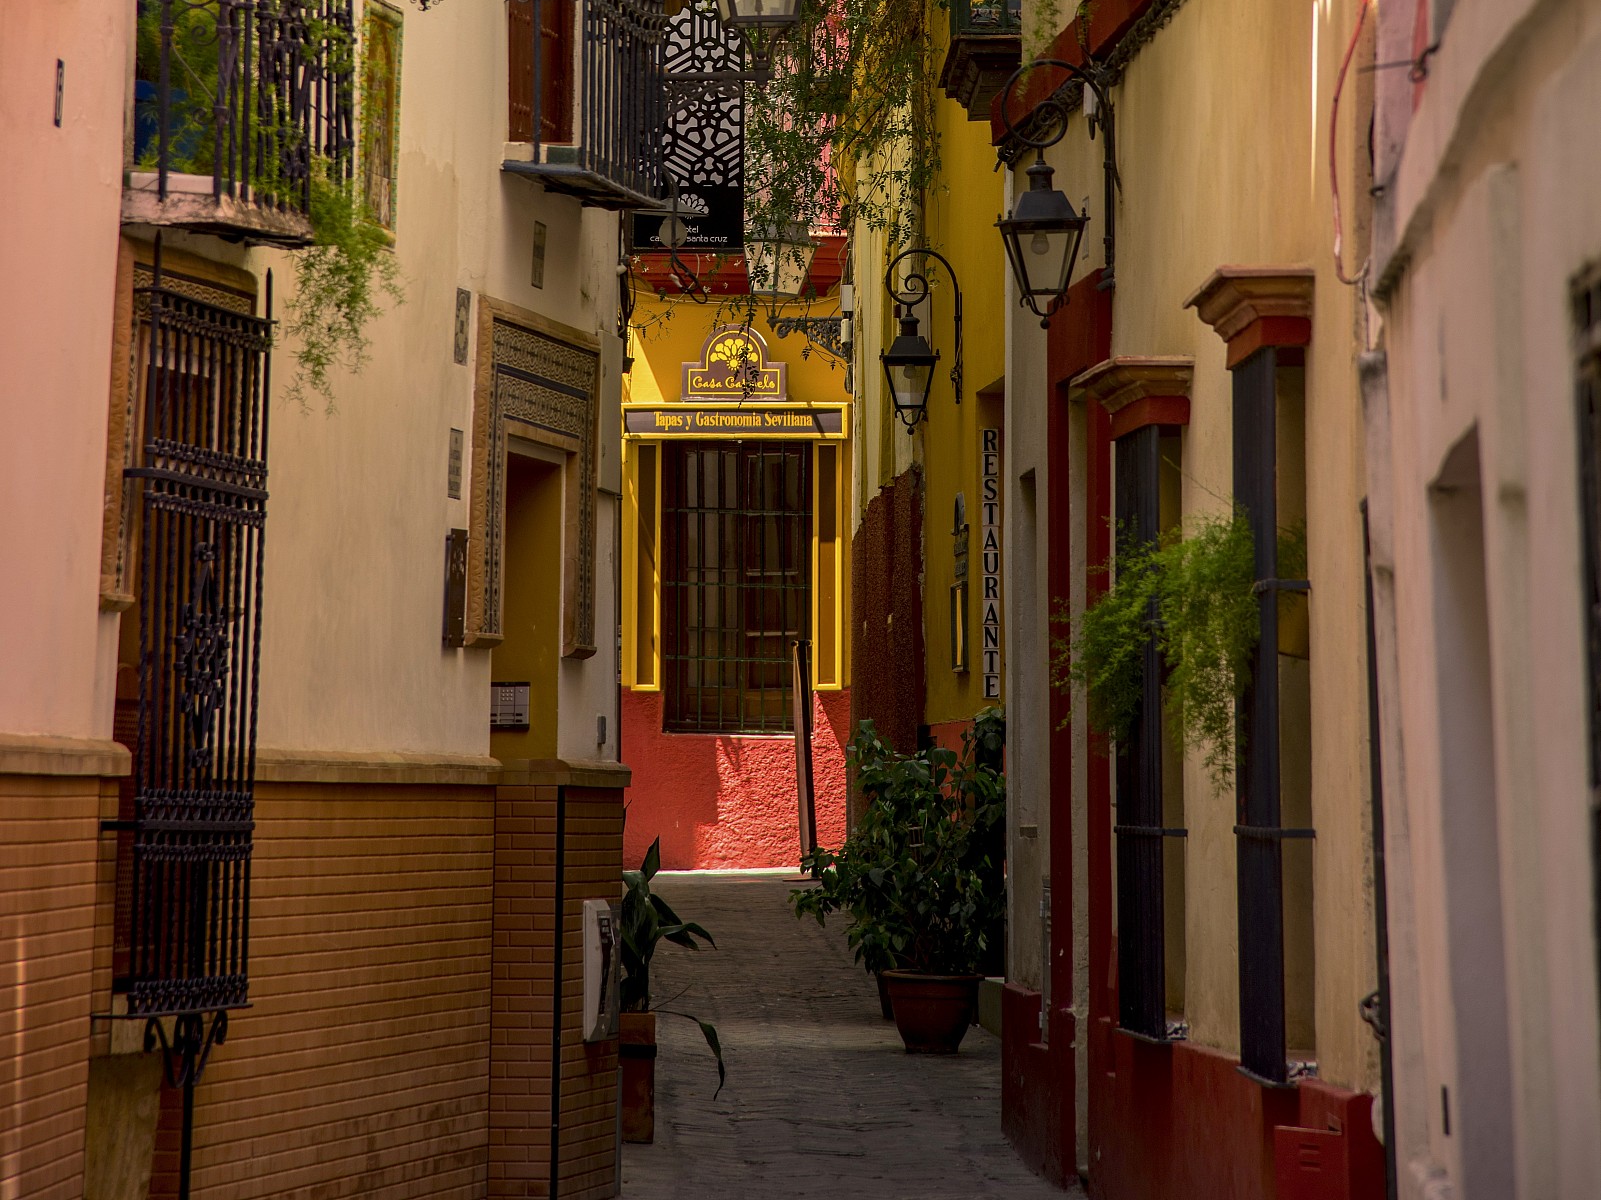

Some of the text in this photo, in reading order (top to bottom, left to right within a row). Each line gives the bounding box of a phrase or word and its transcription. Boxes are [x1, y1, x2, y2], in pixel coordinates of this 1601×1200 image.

[686, 234, 709, 243] santa
[709, 235, 728, 243] cruz
[692, 376, 723, 388] Casa
[653, 411, 683, 431] Tapas
[685, 415, 693, 431] y
[764, 411, 813, 427] Sevillana
[983, 429, 999, 698] RESTAURANTE
